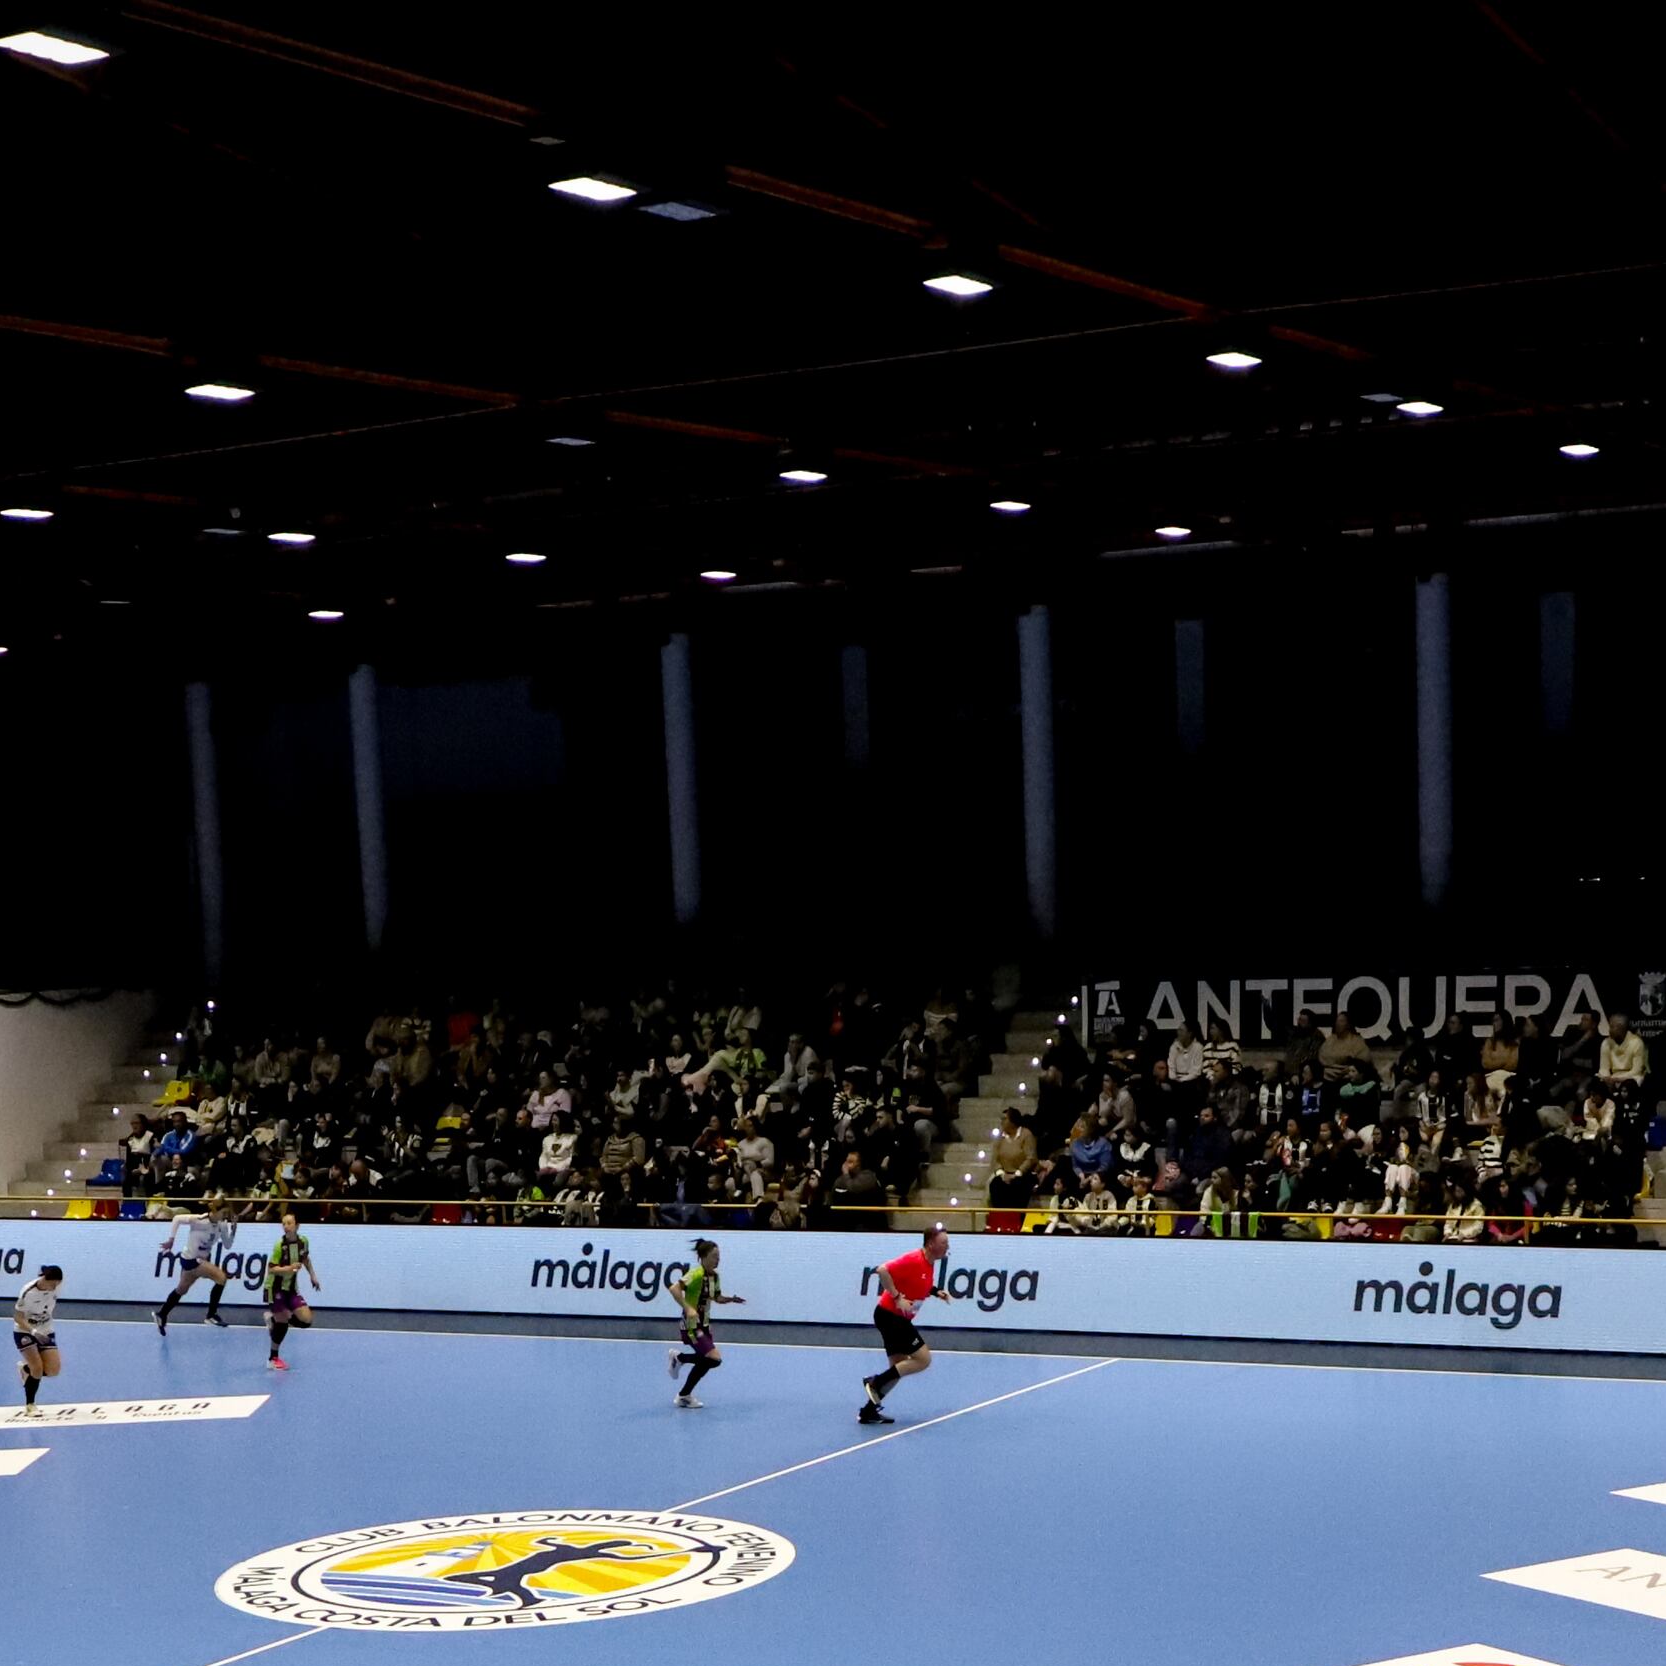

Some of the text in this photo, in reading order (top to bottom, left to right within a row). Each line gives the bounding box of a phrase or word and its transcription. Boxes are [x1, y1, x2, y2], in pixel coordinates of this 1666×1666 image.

[295, 1513, 777, 1587] CLUB BALONMANO FEMENINO
[294, 1608, 442, 1627] COSTA
[463, 1611, 567, 1627] DEL
[577, 1597, 682, 1617] SOL
